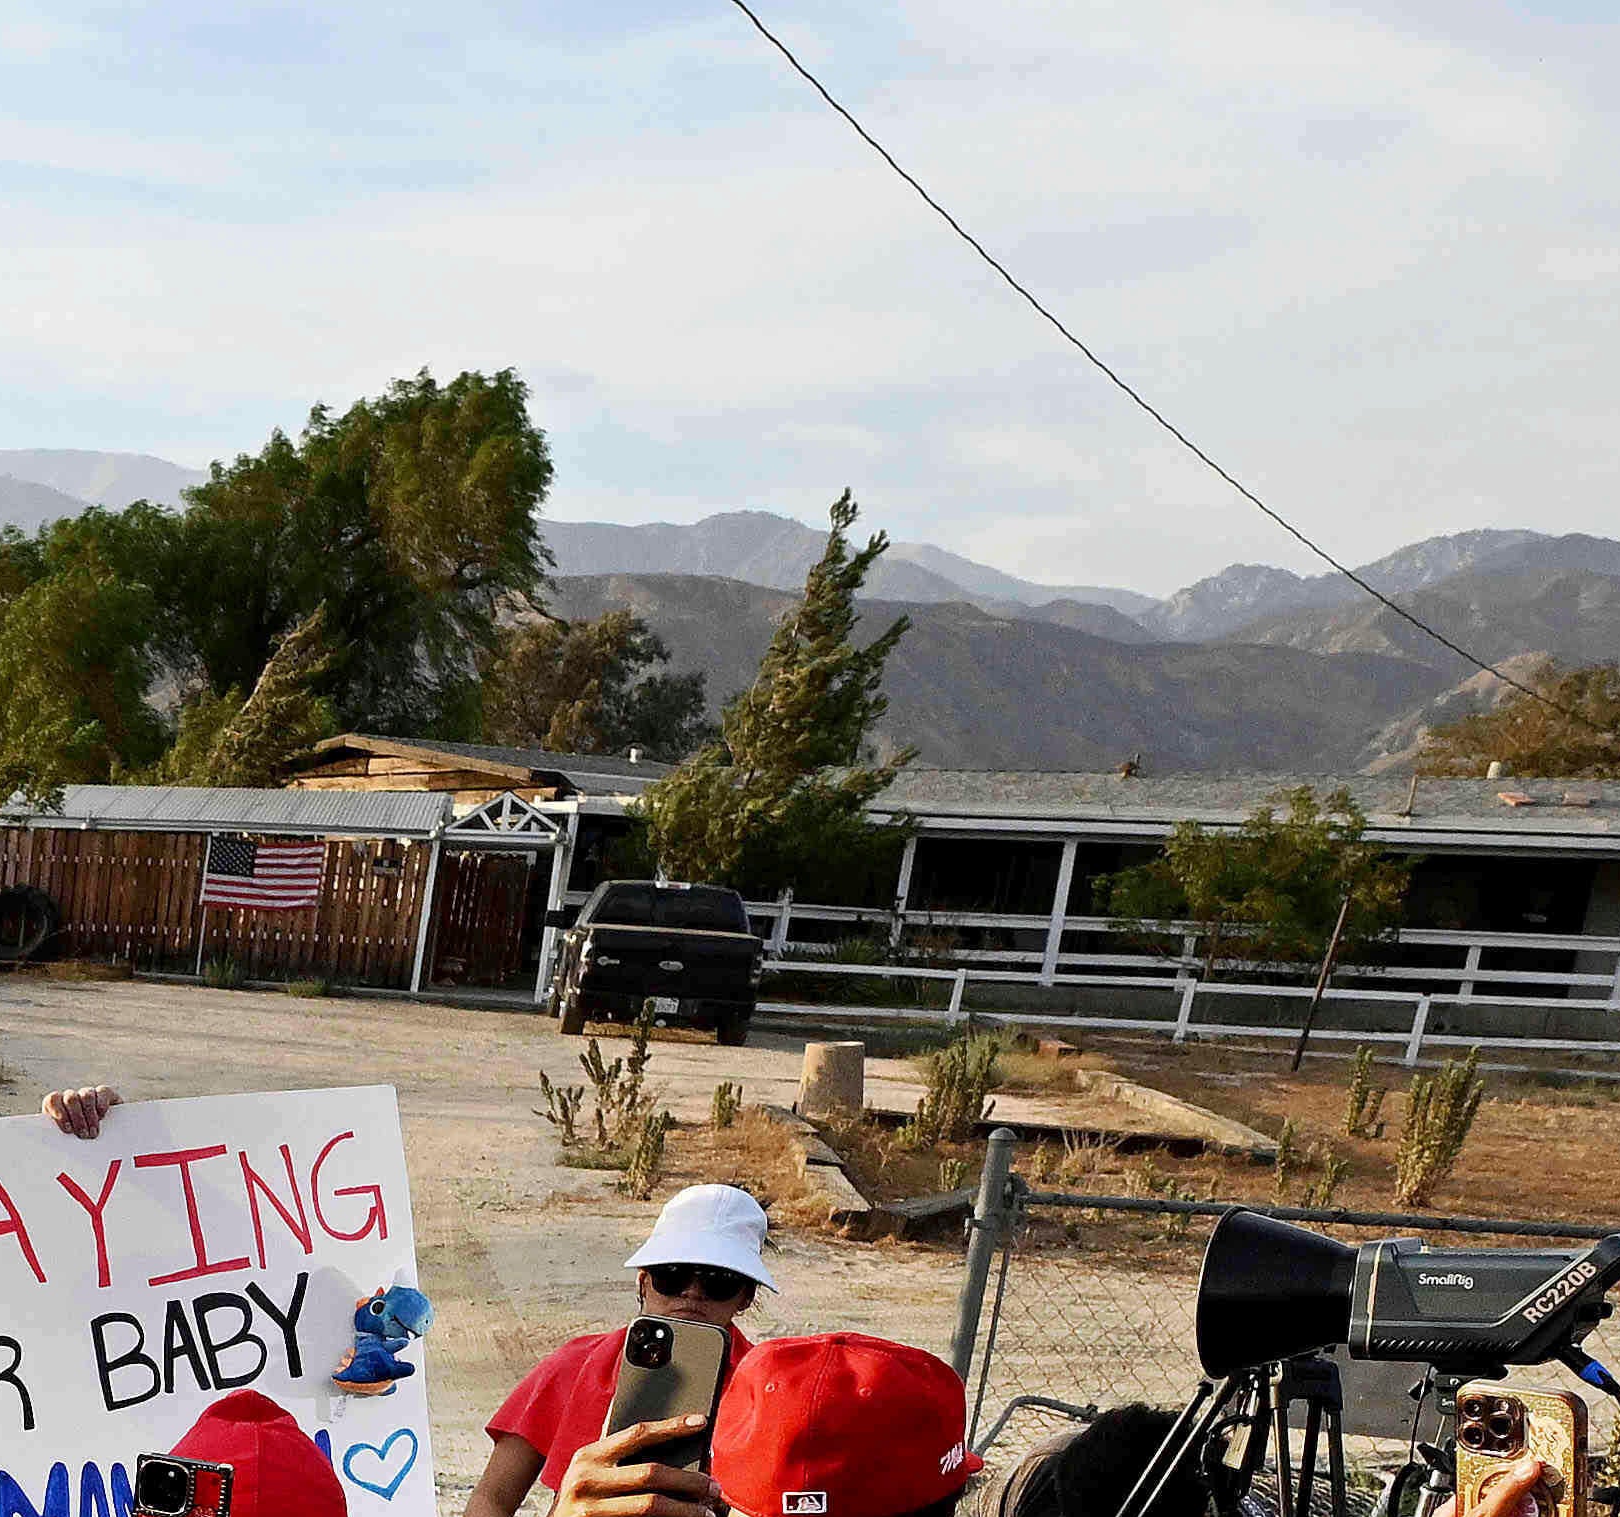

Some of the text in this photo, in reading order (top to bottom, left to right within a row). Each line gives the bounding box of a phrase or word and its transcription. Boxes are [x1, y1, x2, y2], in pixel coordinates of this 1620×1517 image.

[1418, 1273, 1474, 1290] SmallRig
[1522, 1261, 1598, 1325] RC220B
[90, 1272, 309, 1412] BABY
